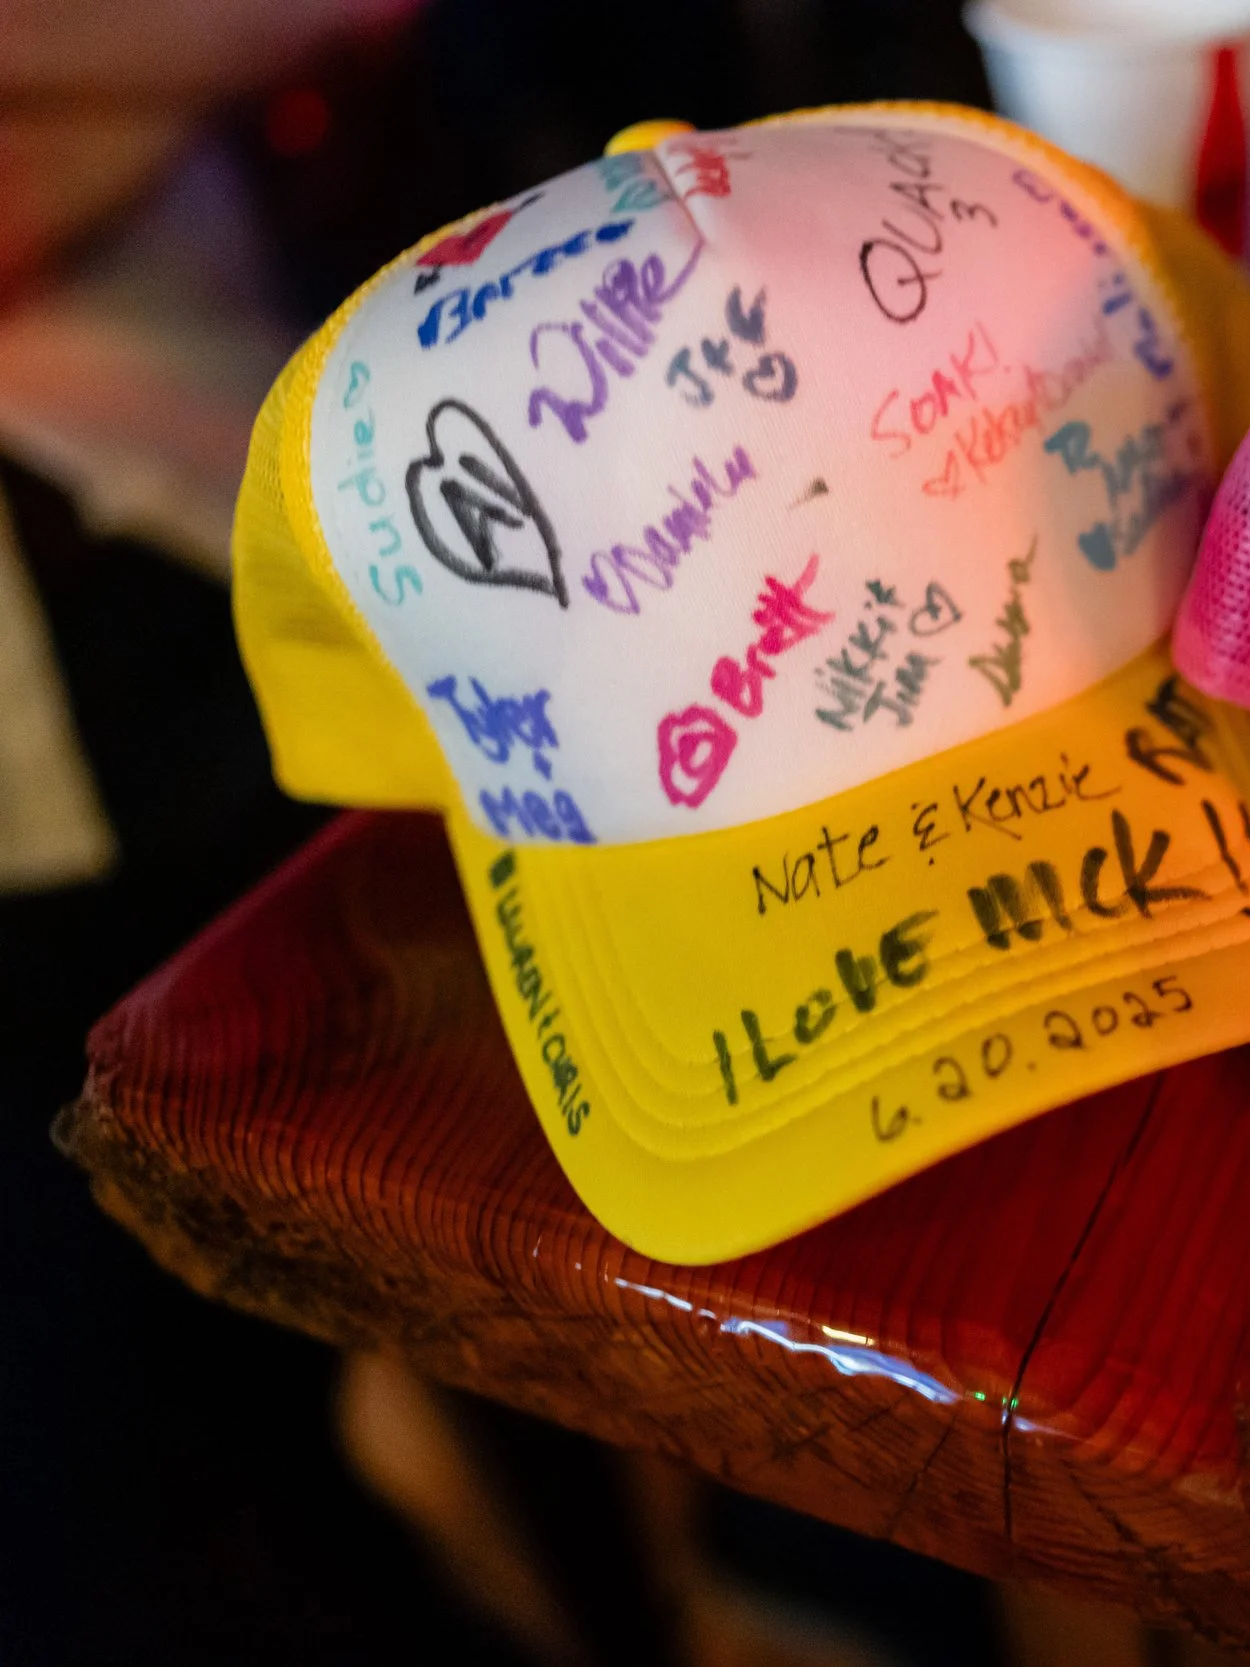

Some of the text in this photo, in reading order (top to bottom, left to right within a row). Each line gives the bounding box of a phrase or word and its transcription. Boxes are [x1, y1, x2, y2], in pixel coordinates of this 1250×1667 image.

[478, 785, 600, 847] Meg
[752, 825, 895, 917] Nate
[952, 752, 1123, 842] Kenzie
[740, 909, 941, 1084] LOVE
[871, 974, 1194, 1144] 6.20.2025
